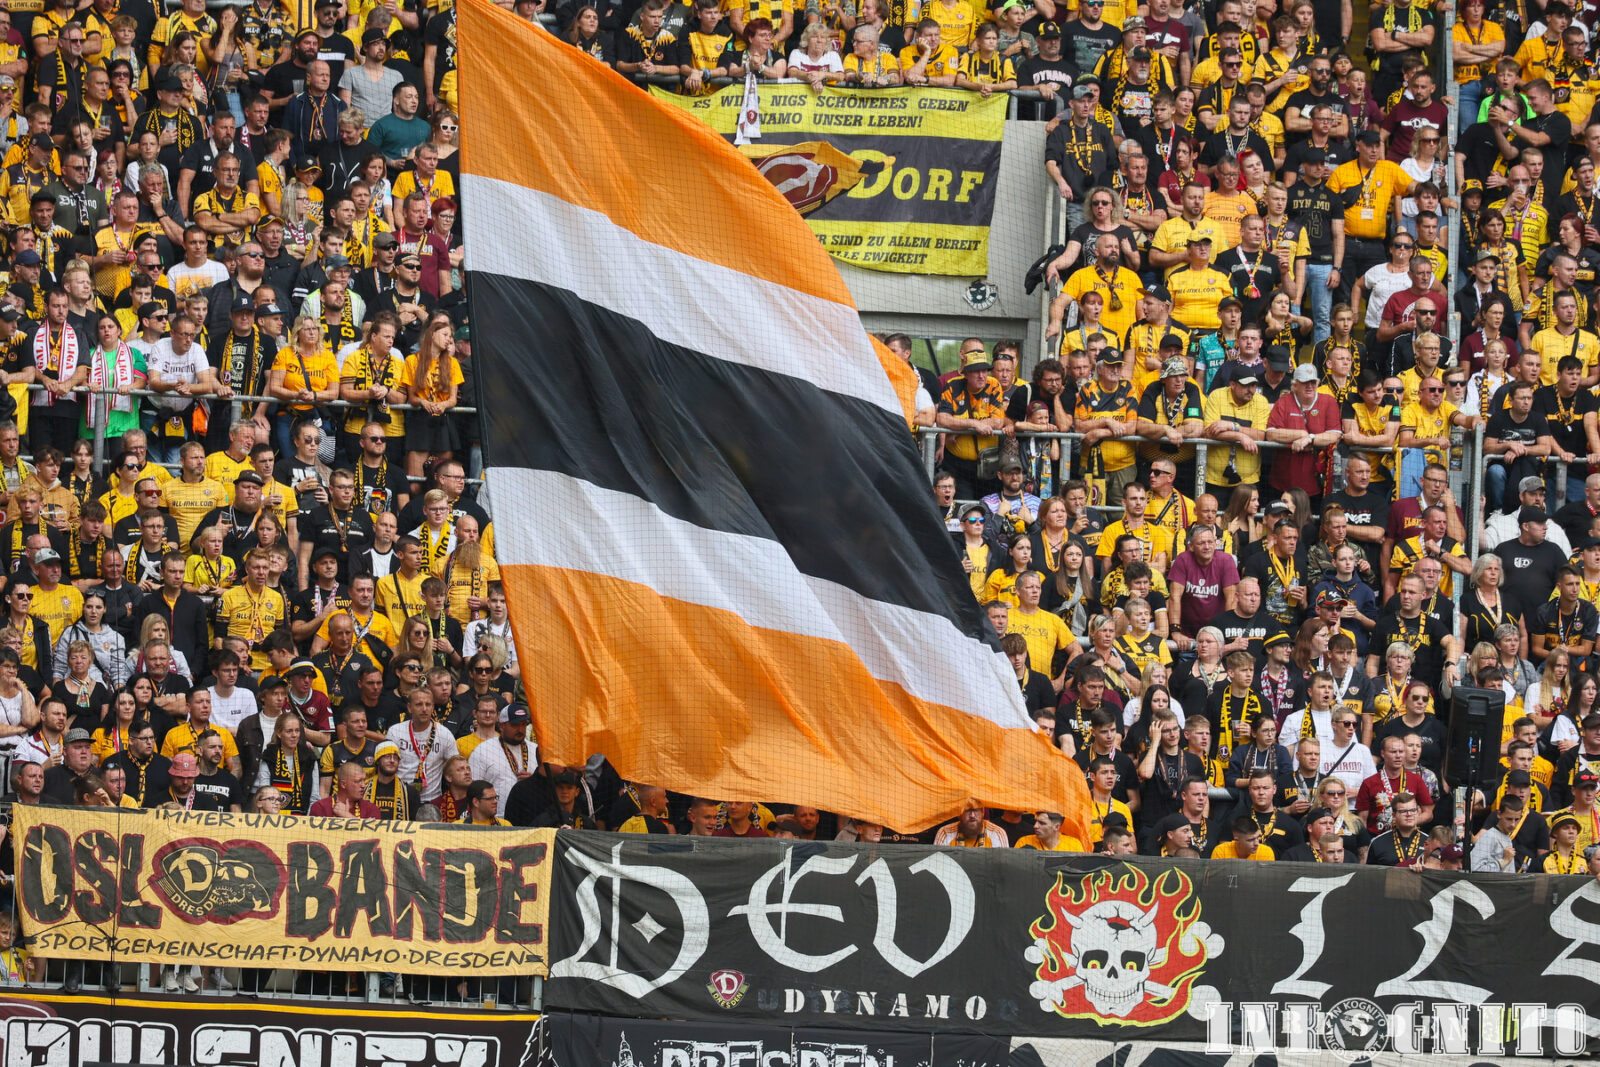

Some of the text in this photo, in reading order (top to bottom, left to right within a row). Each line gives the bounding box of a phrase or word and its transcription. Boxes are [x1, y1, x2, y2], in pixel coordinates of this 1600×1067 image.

[1032, 70, 1073, 87] DYNAMO
[721, 95, 760, 107] WI
[770, 94, 808, 107] NIGS
[816, 94, 908, 110] SCHÖNERES
[918, 97, 969, 112] GEBEN
[735, 112, 923, 128] NAMO UNSER LEBEN!
[847, 149, 984, 203] DORF
[831, 235, 863, 246] SIND
[867, 236, 885, 246] ZU
[888, 236, 931, 248] ALLEM
[935, 238, 981, 250] BEREIT
[862, 251, 928, 264] EWIGKEIT
[1186, 580, 1219, 596] DYNAMO
[155, 808, 235, 828] IMMER
[245, 813, 299, 830] UND
[21, 823, 547, 944] OSL BANDE
[170, 892, 222, 917] DRESDE
[38, 932, 527, 968] SPORTGEMEINSCHAFT DYNAMO DRESDEN
[784, 988, 987, 1021] DYNAMO
